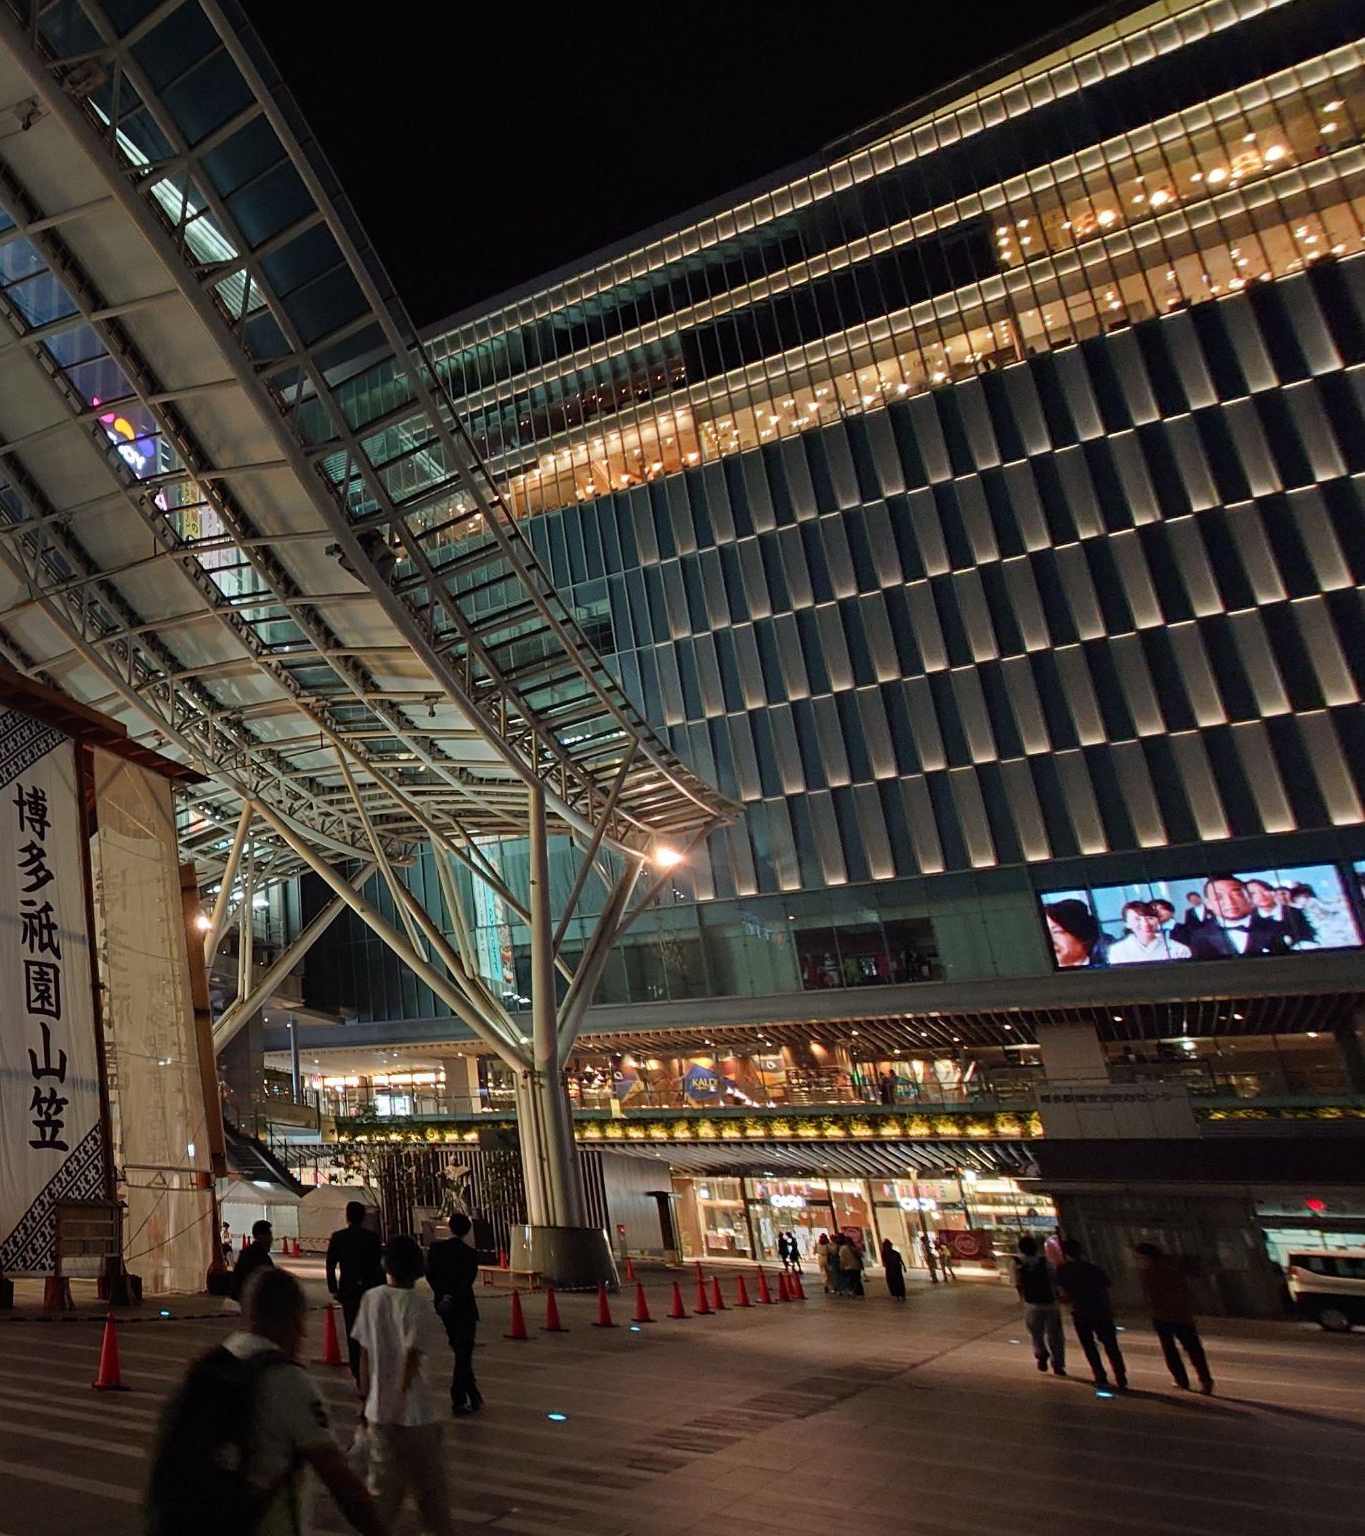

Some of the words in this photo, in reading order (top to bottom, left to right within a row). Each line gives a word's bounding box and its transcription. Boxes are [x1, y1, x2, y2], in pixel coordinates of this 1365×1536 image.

[12, 782, 70, 1153] 博多祇園山笠
